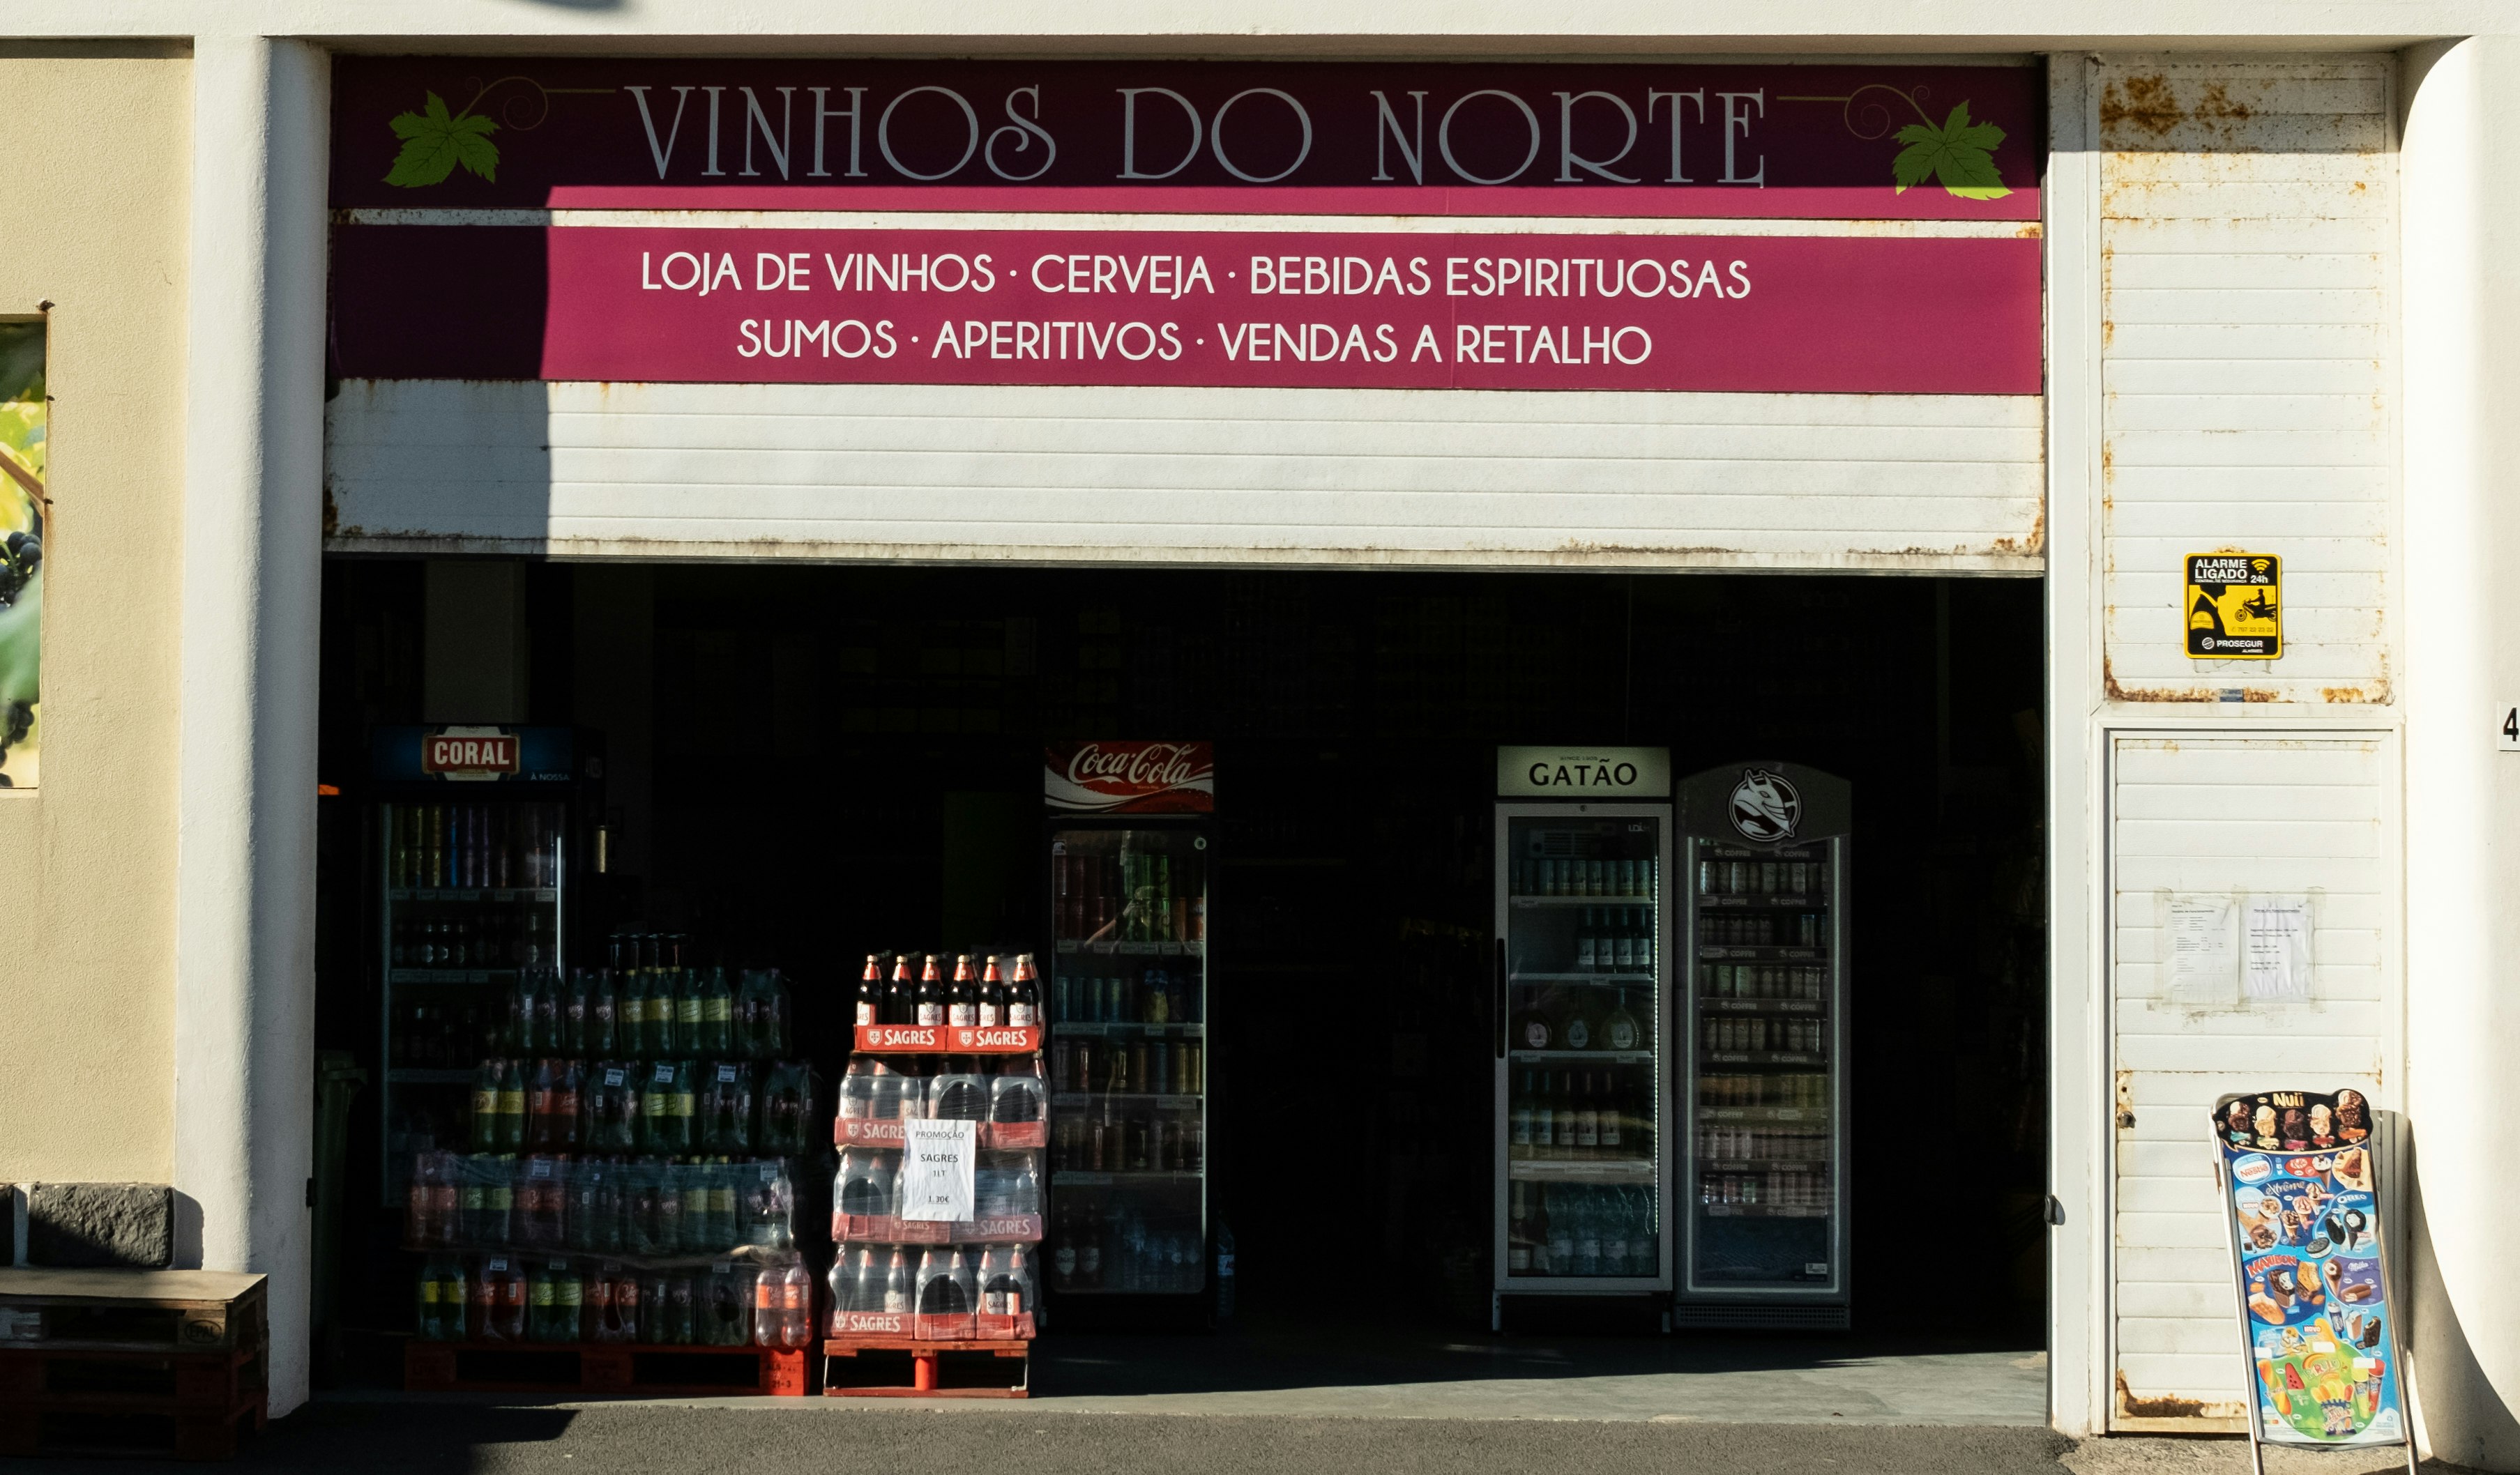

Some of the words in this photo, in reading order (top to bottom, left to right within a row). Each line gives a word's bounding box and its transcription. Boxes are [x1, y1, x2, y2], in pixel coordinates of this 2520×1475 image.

[625, 84, 1056, 181] VINHOS
[1116, 87, 1312, 183] DO
[1369, 86, 1764, 188] NORTE
[642, 251, 743, 297] LOJA
[757, 252, 810, 291] DE
[824, 253, 996, 293] VINHOS
[1031, 254, 1215, 300] CERVEJA
[1251, 256, 1432, 296] BEBIDAS
[1446, 257, 1751, 303] ESPIRITUOSAS
[736, 319, 897, 359] SUMOS
[931, 320, 1183, 361] APERITIVOS
[1217, 323, 1398, 363] VENDAS
[1411, 324, 1443, 362] A
[1457, 325, 1652, 366] RETALHO
[2196, 559, 2247, 568] ALARME
[2195, 569, 2247, 579] LIGADO
[2250, 575, 2268, 583] 24h
[434, 741, 510, 765] CORAL
[1068, 743, 1199, 784] Coca-Cola
[1529, 758, 1637, 786] GATÃO
[884, 1029, 935, 1046] SAGRES
[976, 1030, 1027, 1047] SAGRES
[2272, 1092, 2305, 1107] Nuii
[863, 1122, 904, 1140] SAGRE
[916, 1130, 964, 1140] PROMOÇÃO
[920, 1154, 959, 1163] SAGRES
[2337, 1194, 2367, 1204] OREO
[903, 1221, 929, 1230] SAGRES
[980, 1219, 1031, 1235] SAGRES
[850, 1315, 901, 1333] SAGRES
